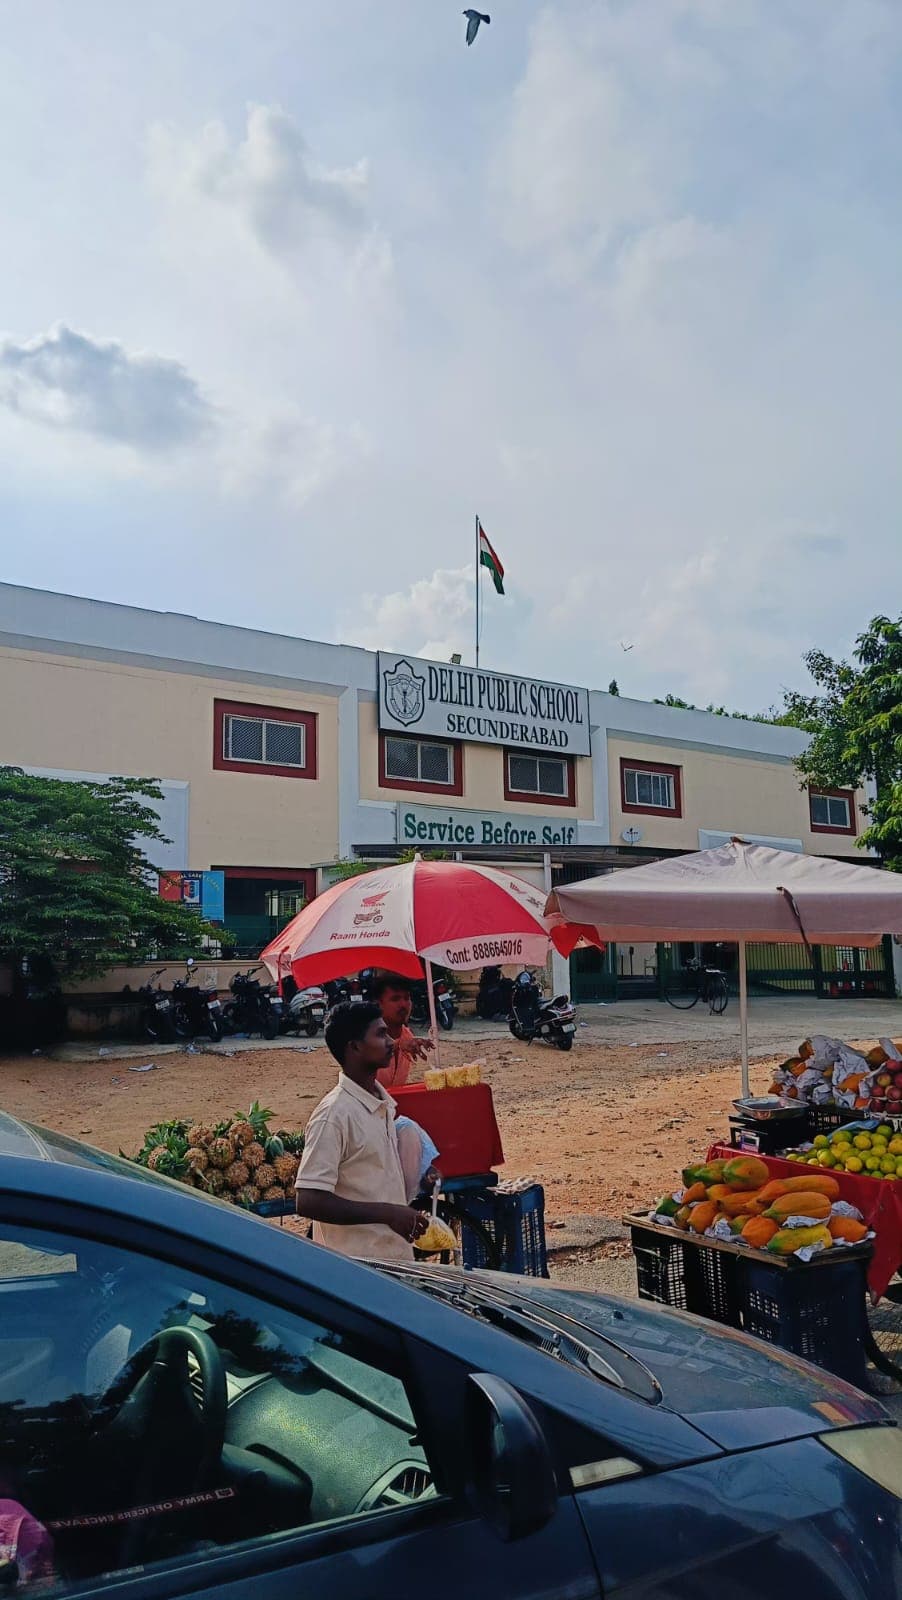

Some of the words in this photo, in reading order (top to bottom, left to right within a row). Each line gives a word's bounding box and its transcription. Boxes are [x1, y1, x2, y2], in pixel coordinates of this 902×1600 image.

[427, 665, 475, 707] DELHI
[477, 675, 529, 716] PUBLIC
[530, 684, 583, 724] SCHOOL
[447, 713, 569, 748] SECUNDERABAD
[404, 812, 475, 843] Service
[481, 820, 536, 844] Before
[542, 826, 574, 844] Self
[329, 932, 358, 941] Raam
[359, 929, 391, 939] Honda
[446, 946, 472, 964] Cont:
[472, 938, 523, 960] 8886645016
